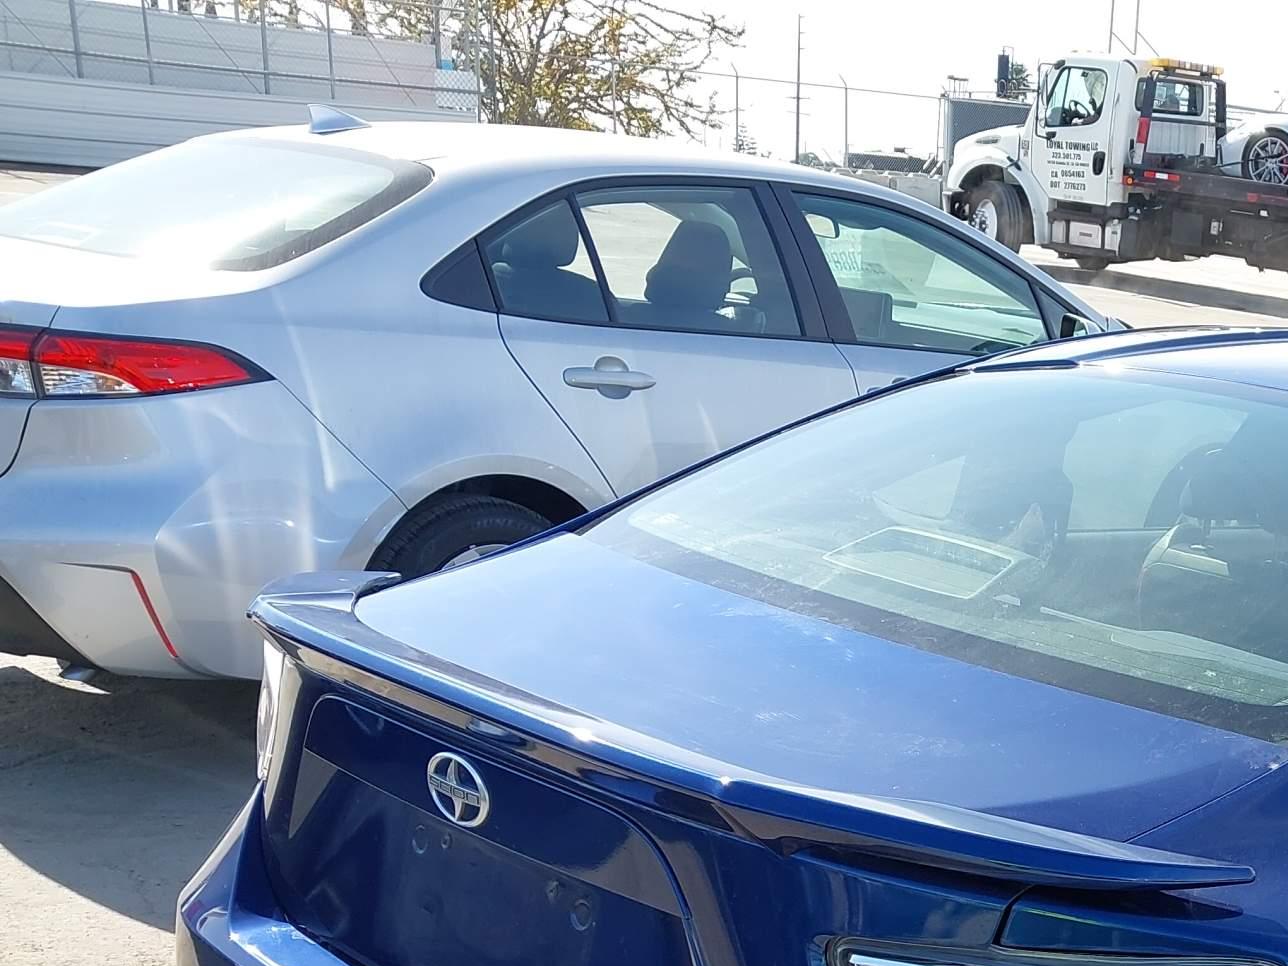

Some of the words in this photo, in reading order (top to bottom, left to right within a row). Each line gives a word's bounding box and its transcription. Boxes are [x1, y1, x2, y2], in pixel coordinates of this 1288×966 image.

[1046, 139, 1064, 150] LOYAL
[1065, 141, 1090, 152] TOWING
[1091, 141, 1099, 151] LLC
[429, 774, 480, 807] SCION
